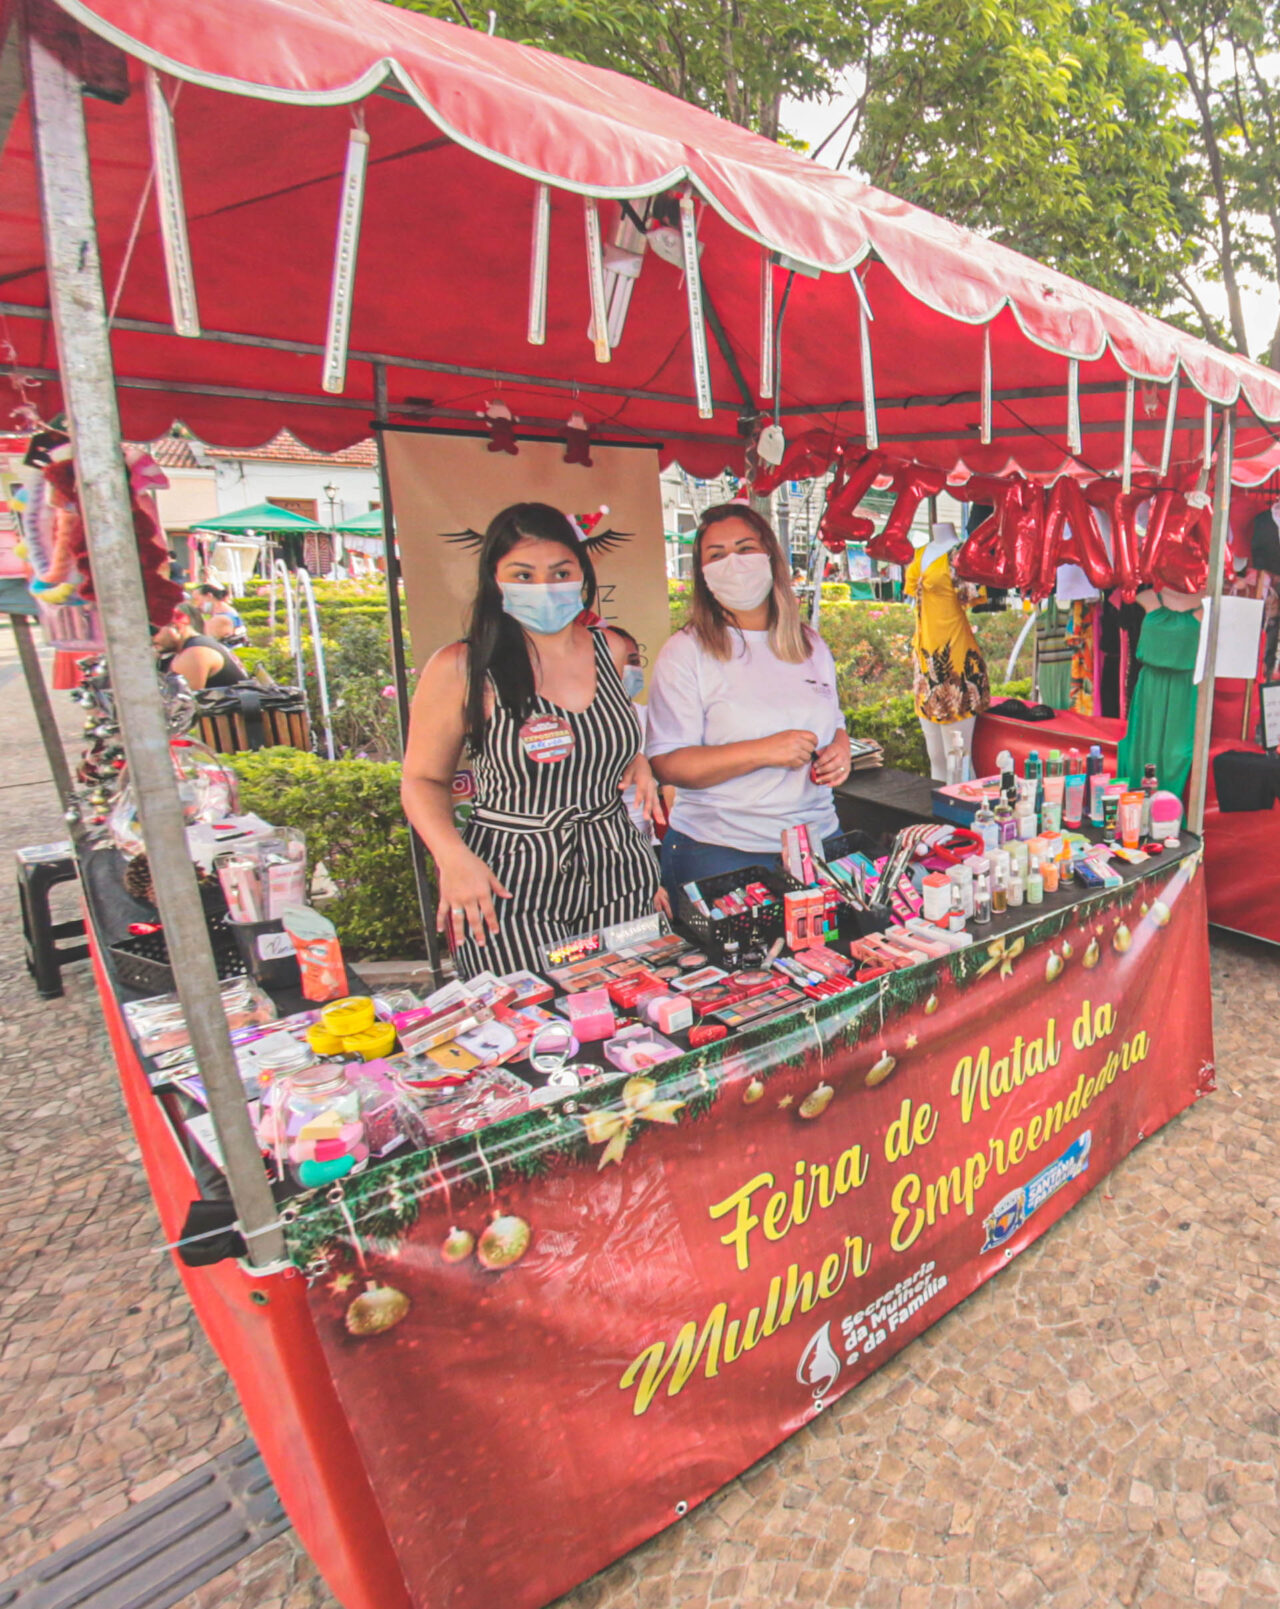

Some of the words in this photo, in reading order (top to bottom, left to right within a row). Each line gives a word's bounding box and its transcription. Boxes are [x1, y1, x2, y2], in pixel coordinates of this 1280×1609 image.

[708, 1144, 870, 1271] Feira
[884, 1098, 939, 1163] de
[950, 1017, 1062, 1123] Natal
[1072, 1000, 1118, 1050] da
[618, 1235, 873, 1416] Mulher
[889, 1030, 1151, 1252] Empreendedora
[840, 1260, 936, 1336] Secretaria
[844, 1325, 869, 1352] da
[870, 1273, 933, 1330] Mulher
[846, 1351, 860, 1366] e
[863, 1328, 887, 1354] da
